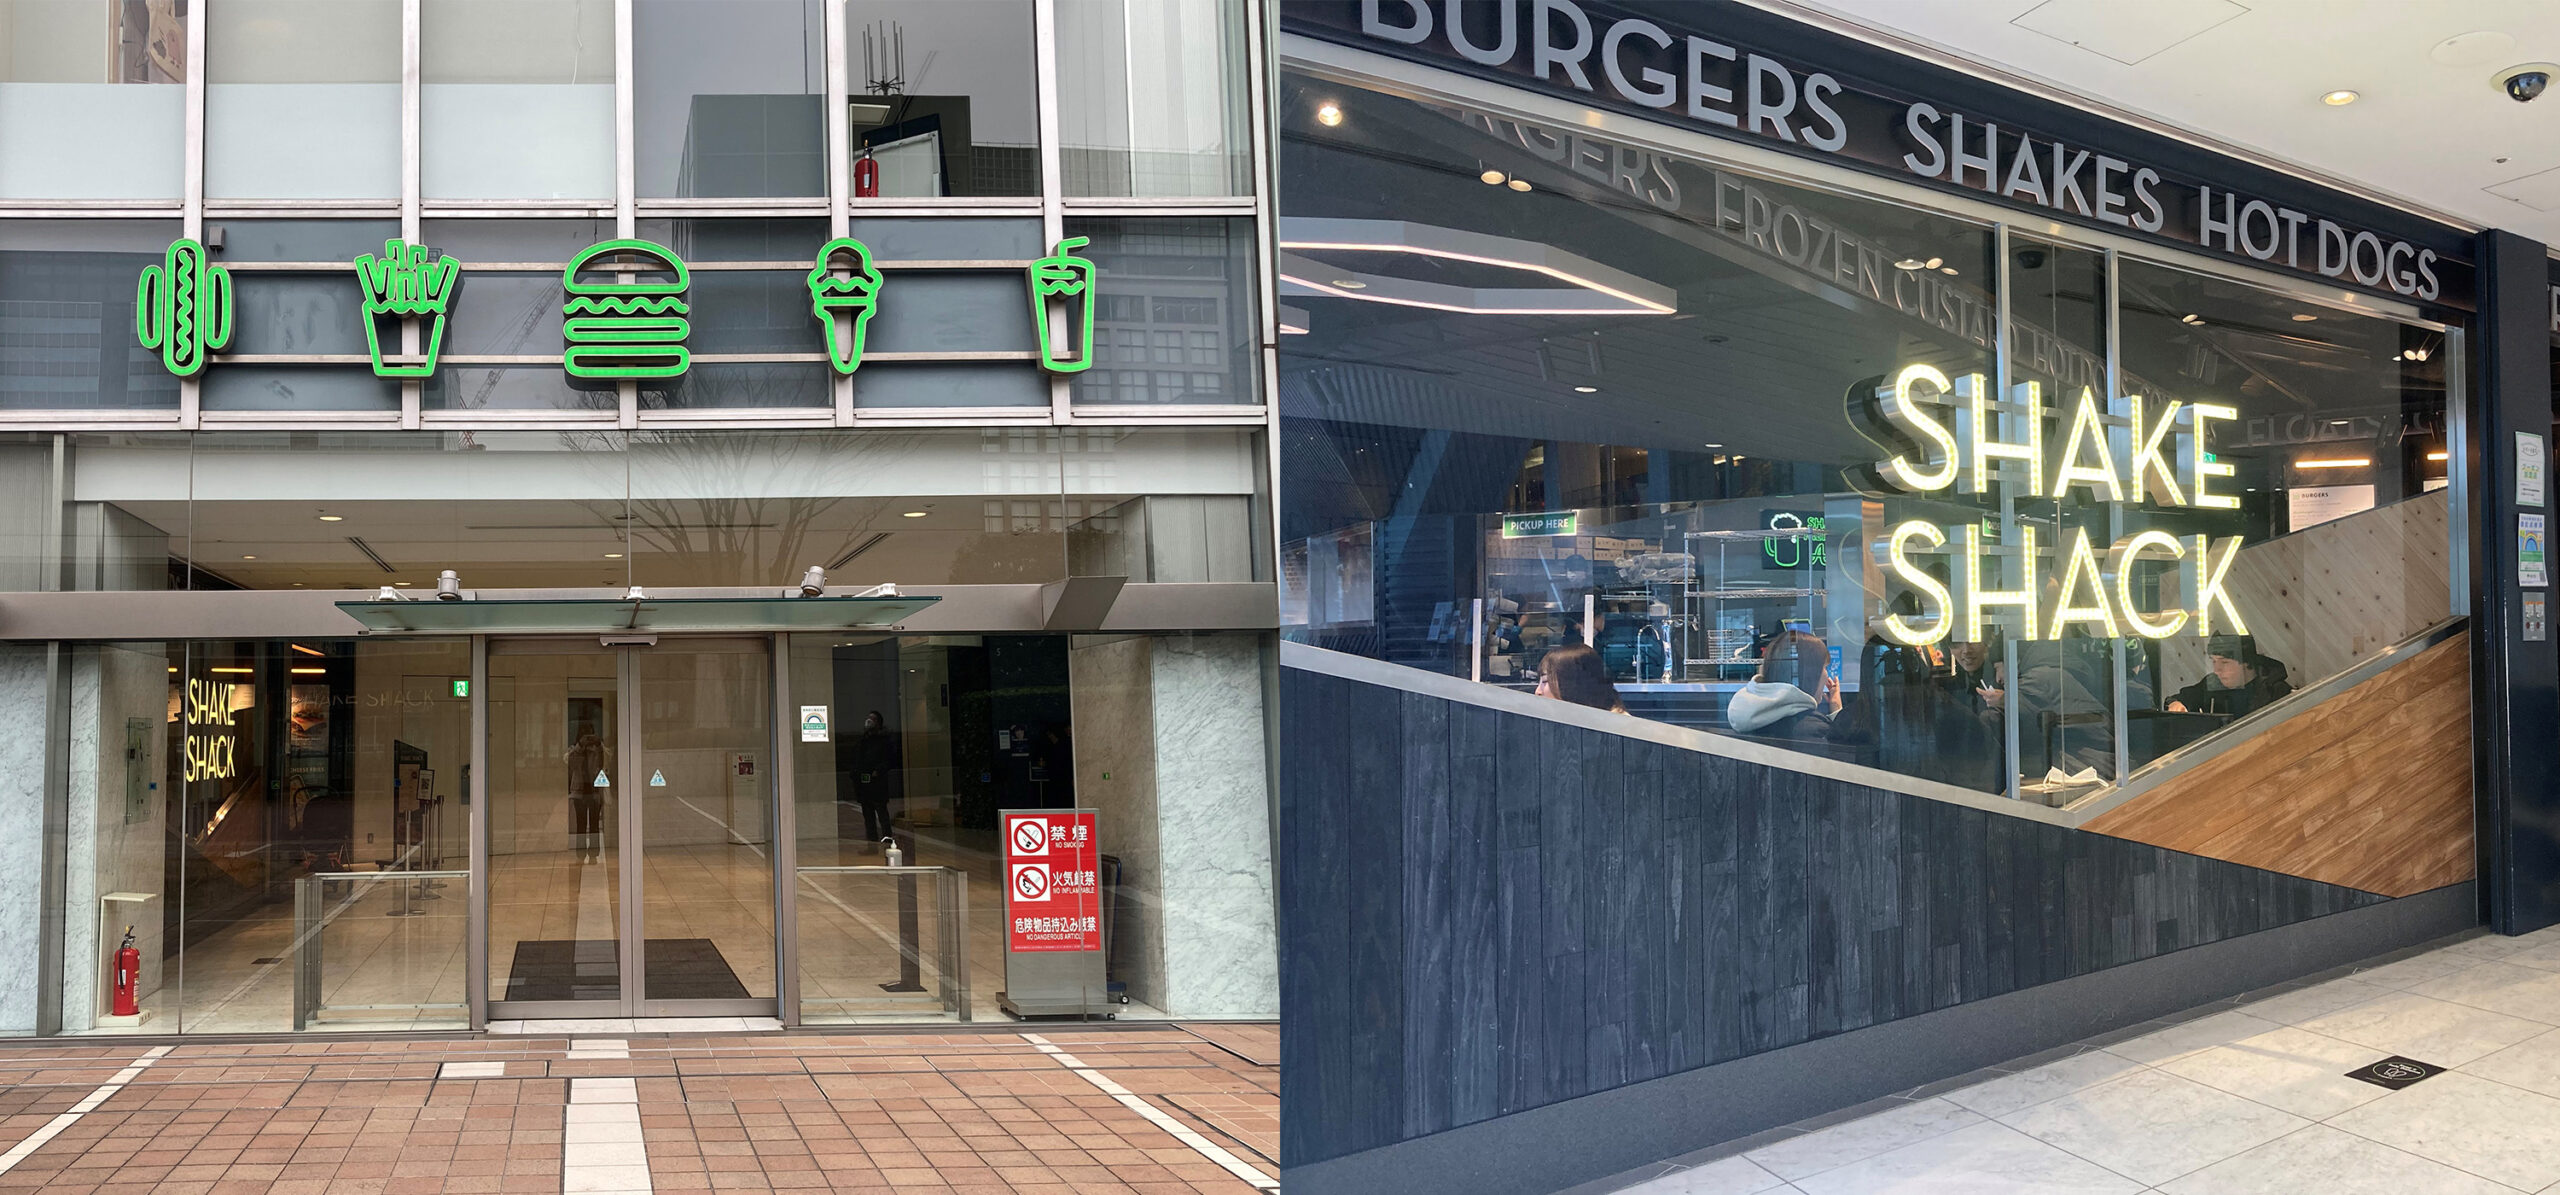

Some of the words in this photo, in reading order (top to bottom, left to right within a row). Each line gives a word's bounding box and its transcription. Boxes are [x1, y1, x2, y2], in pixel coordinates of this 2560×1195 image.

[1903, 102, 2165, 234] SHAKES
[2200, 185, 2308, 269] HOT
[2317, 218, 2440, 301] DOGS
[1715, 170, 1884, 302] FROZEN
[1891, 363, 2241, 510] SHAKE
[1511, 520, 1544, 531] PICKUP
[1546, 518, 1569, 529] HERE
[1885, 519, 2250, 646] SHACK
[188, 678, 236, 726] SHAKE
[185, 735, 236, 783] SHACK
[1055, 841, 1063, 849] NO
[1053, 887, 1061, 895] NO
[1026, 933, 1034, 941] NO
[1034, 932, 1064, 941] DANGEROUS
